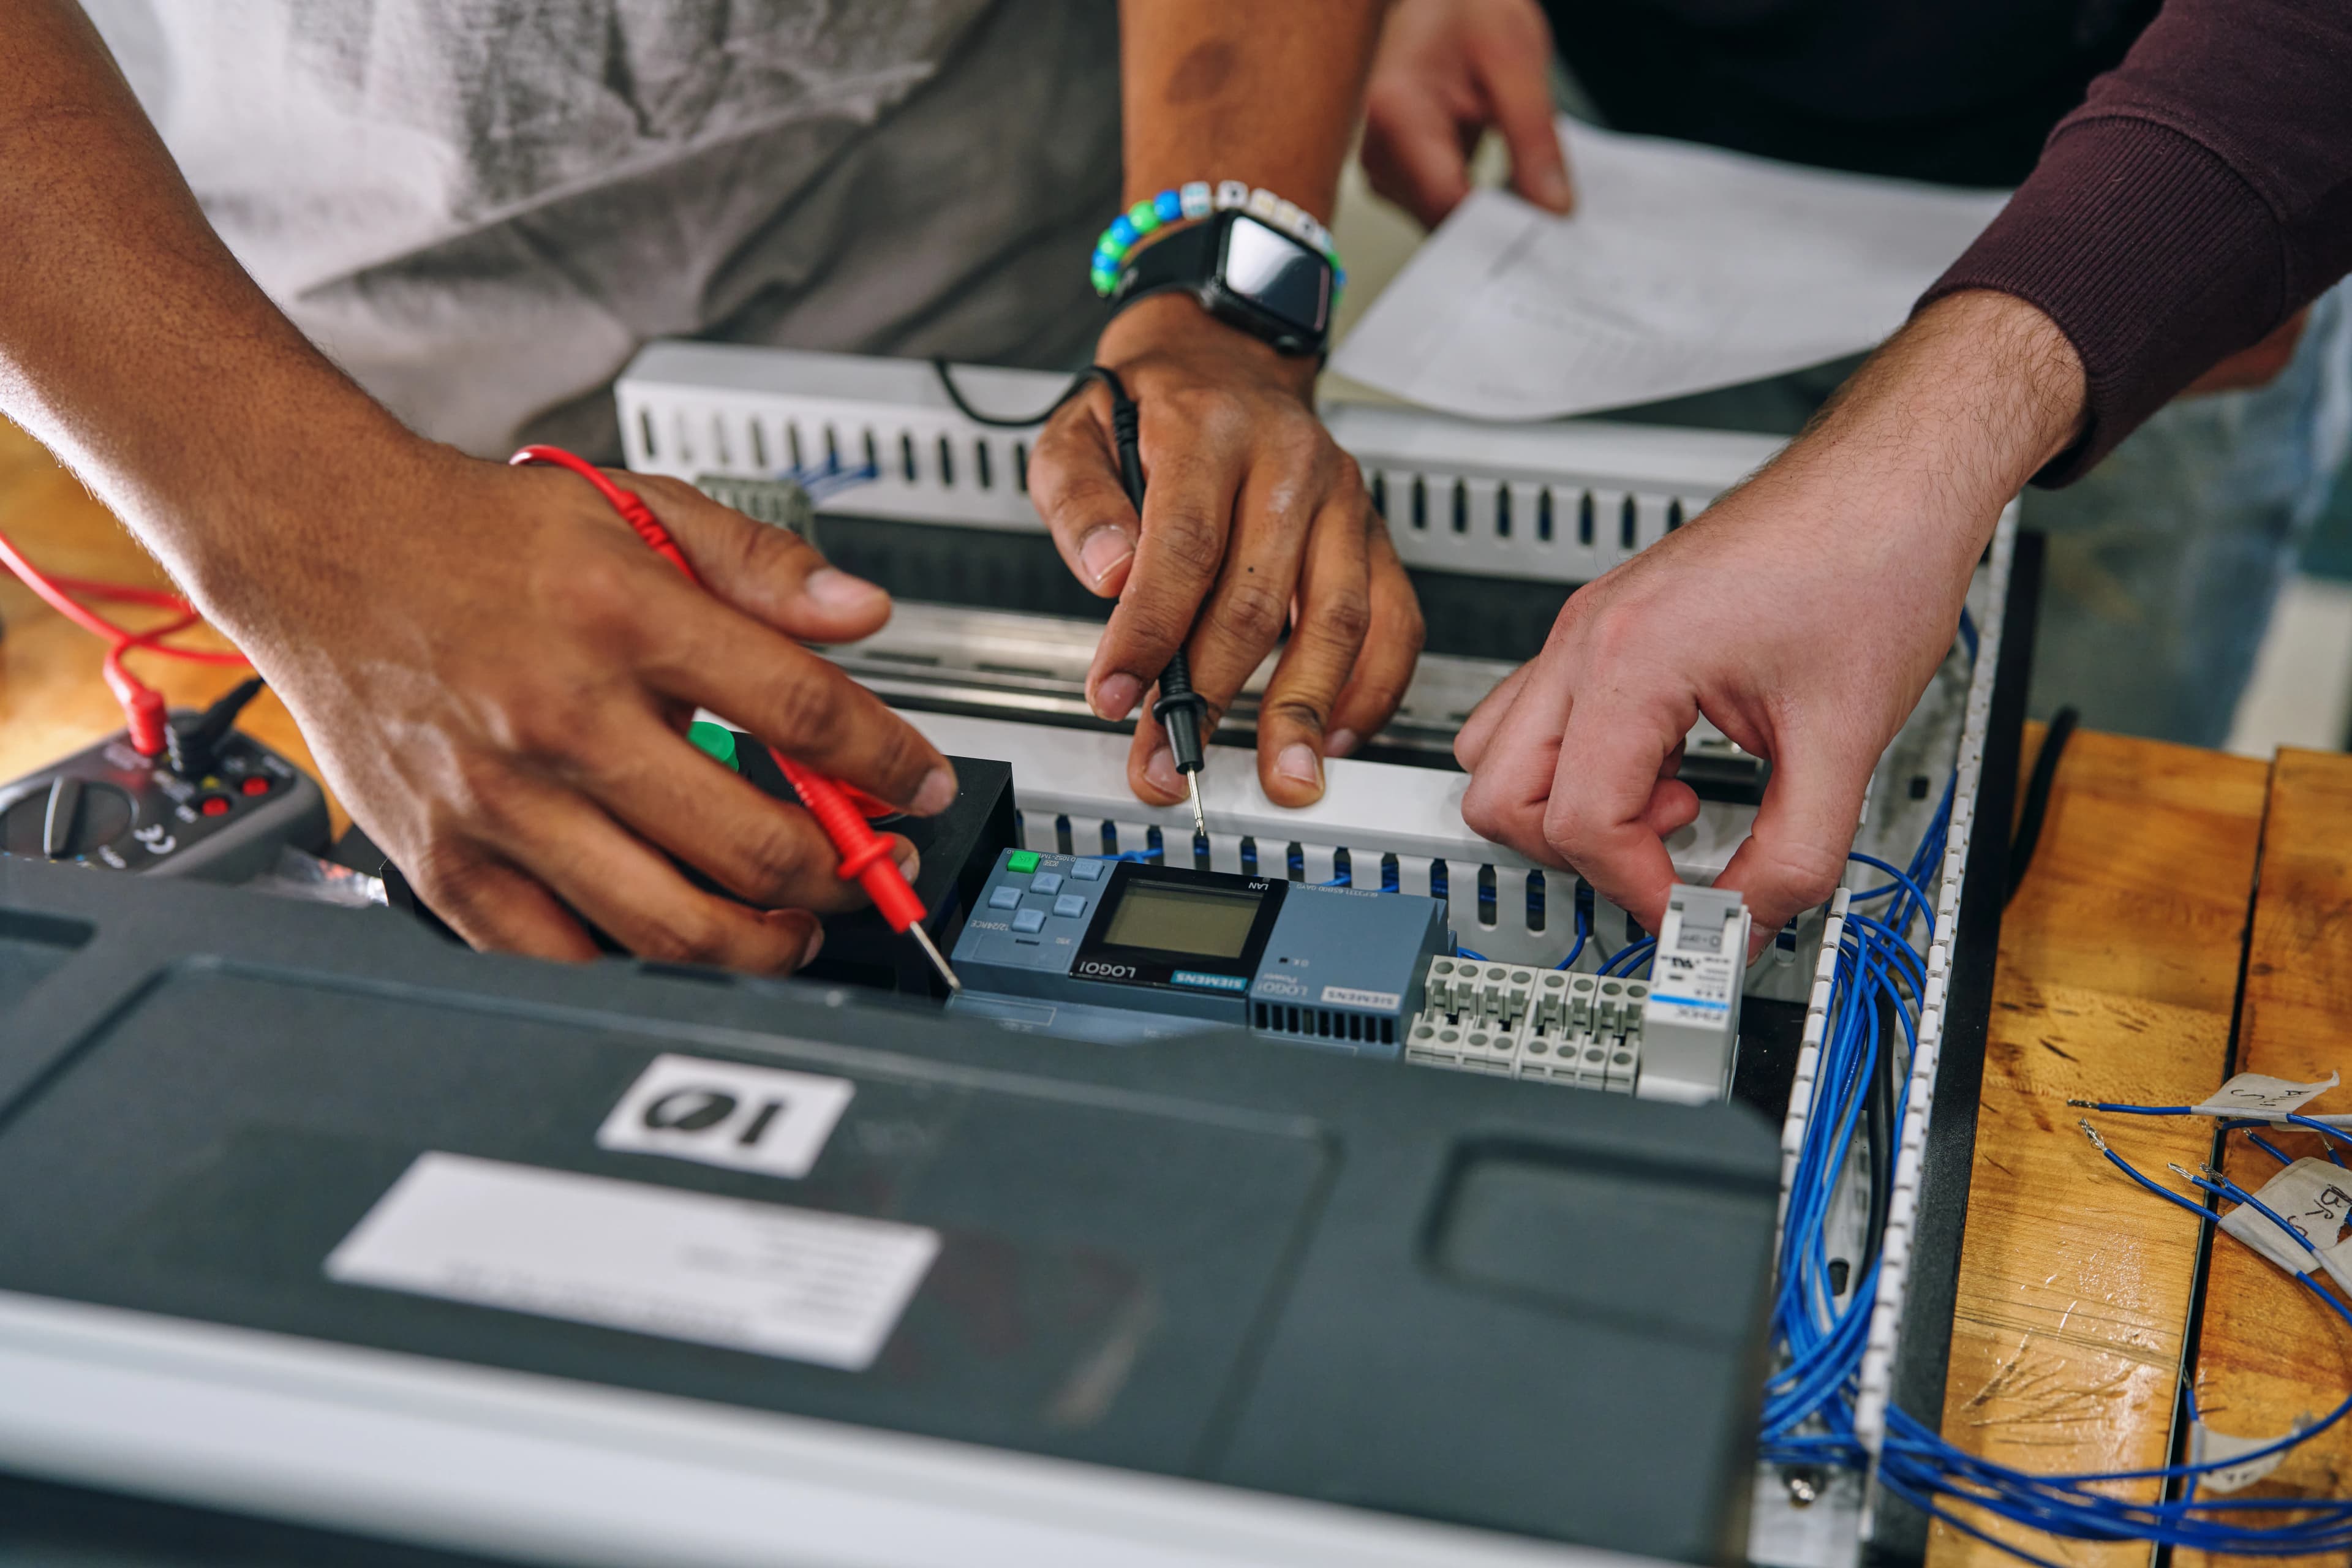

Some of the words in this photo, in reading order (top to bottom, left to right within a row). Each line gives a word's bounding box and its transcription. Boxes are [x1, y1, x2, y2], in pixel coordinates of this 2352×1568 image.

[1248, 881, 1269, 891] LAN
[1079, 960, 1136, 979] LOGO!
[1175, 973, 1243, 988] SIEMENS
[1256, 982, 1308, 997] LOGO!
[1328, 990, 1394, 1006] SIEMENS
